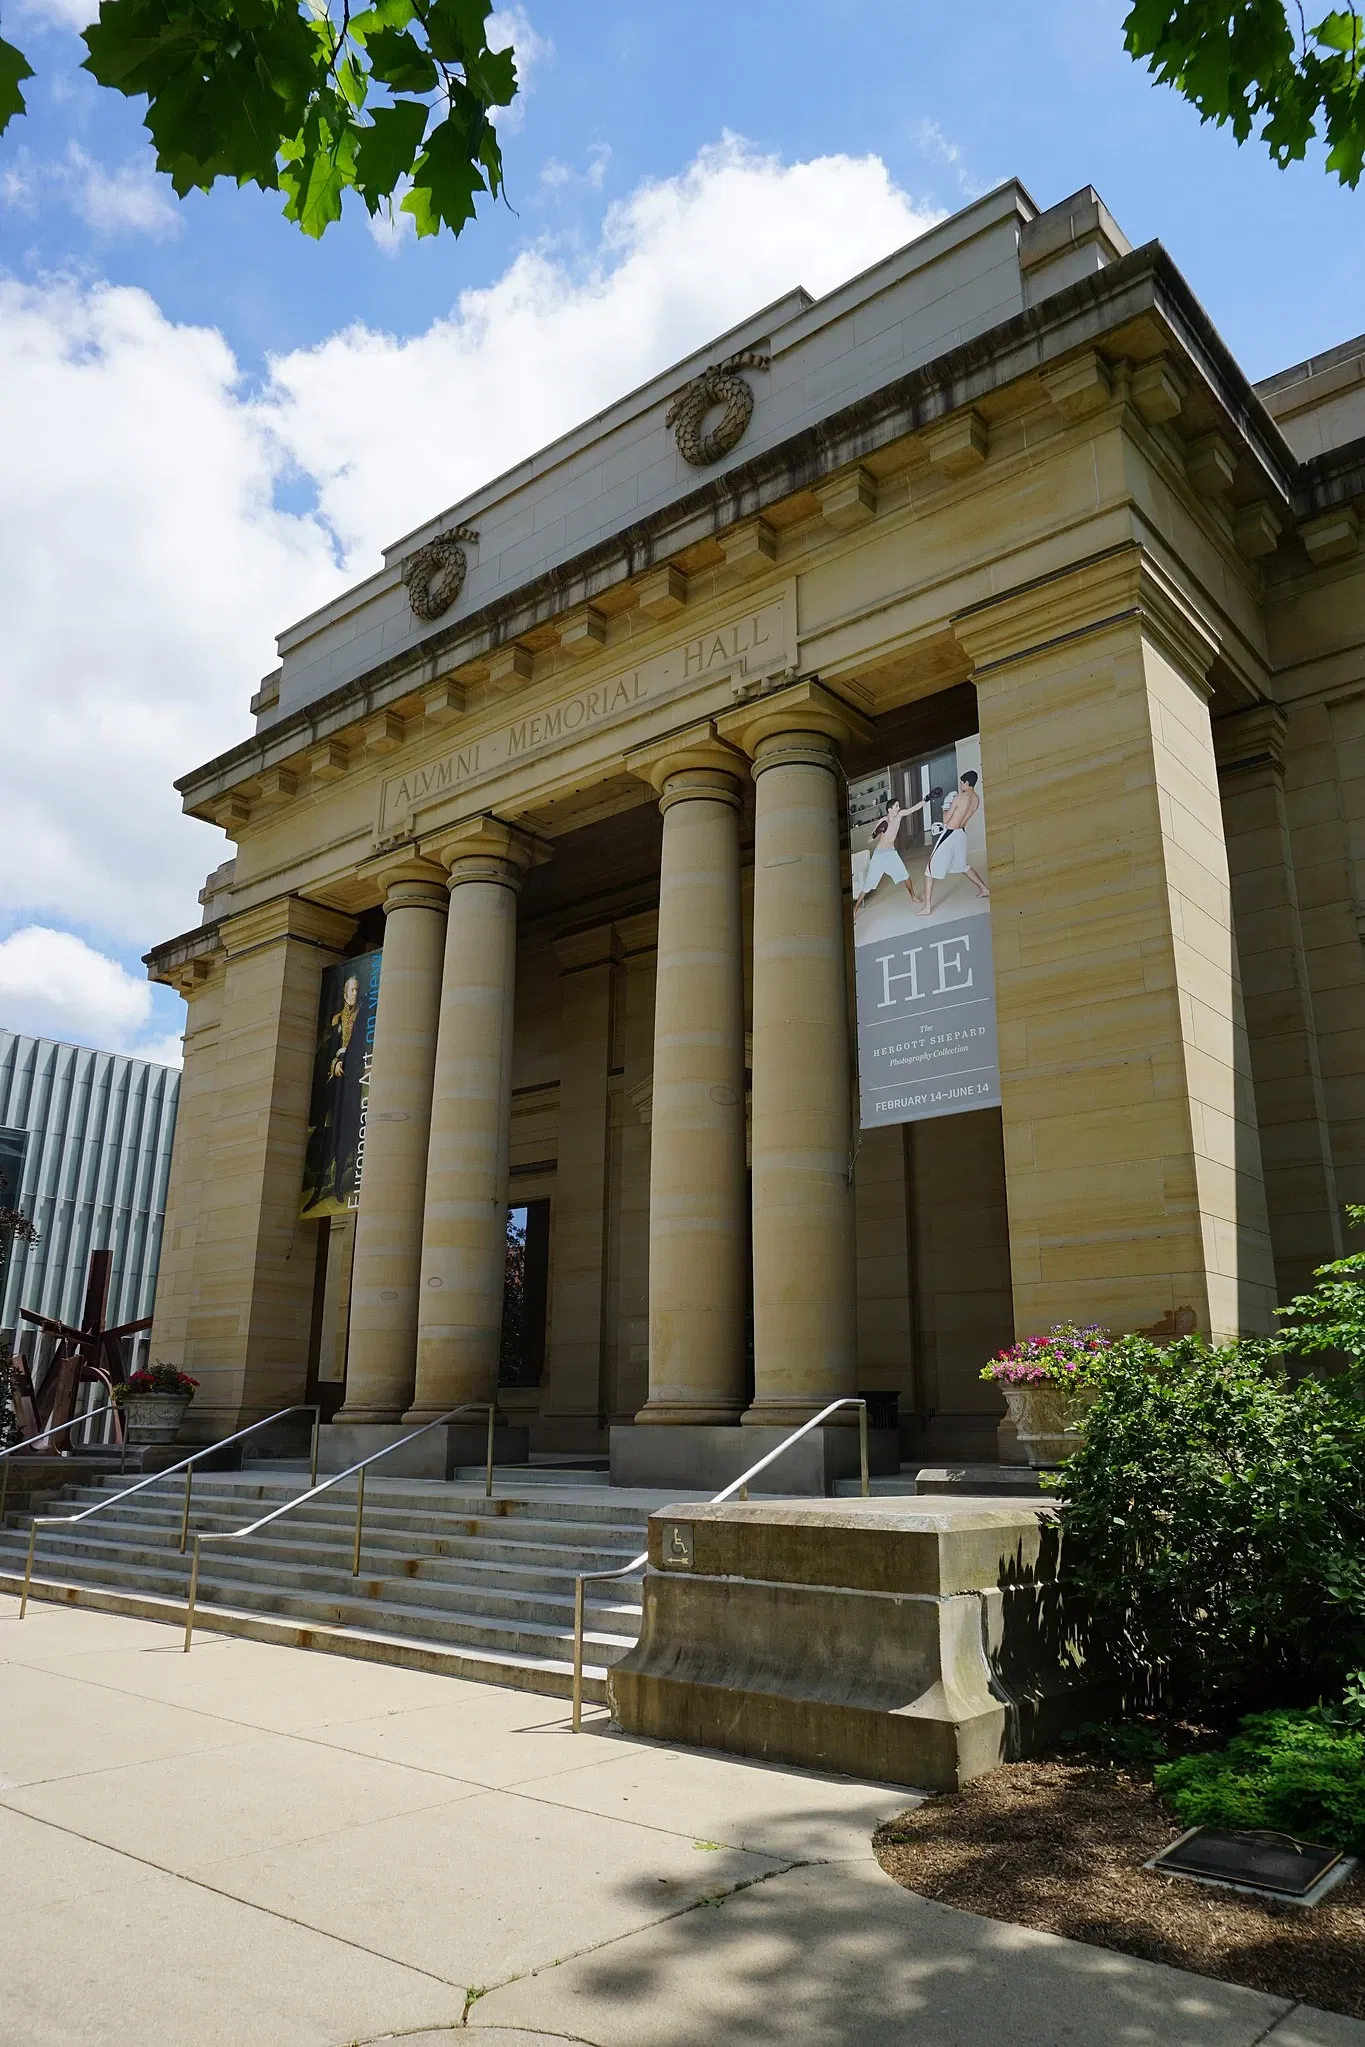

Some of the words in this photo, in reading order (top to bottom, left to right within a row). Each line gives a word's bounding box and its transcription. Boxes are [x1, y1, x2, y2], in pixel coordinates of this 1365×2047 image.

[508, 671, 648, 756] MEMORIAL
[683, 616, 770, 678] HALL
[875, 934, 974, 1008] HE
[873, 1039, 926, 1057] HERGOTT
[930, 1027, 986, 1045] SHEPARD
[919, 1024, 933, 1033] The
[358, 1051, 373, 1085] Art
[889, 1052, 933, 1067] Photography
[933, 1044, 969, 1058] Collection
[875, 1094, 928, 1112] FEBRUARY
[976, 1082, 990, 1094] 14
